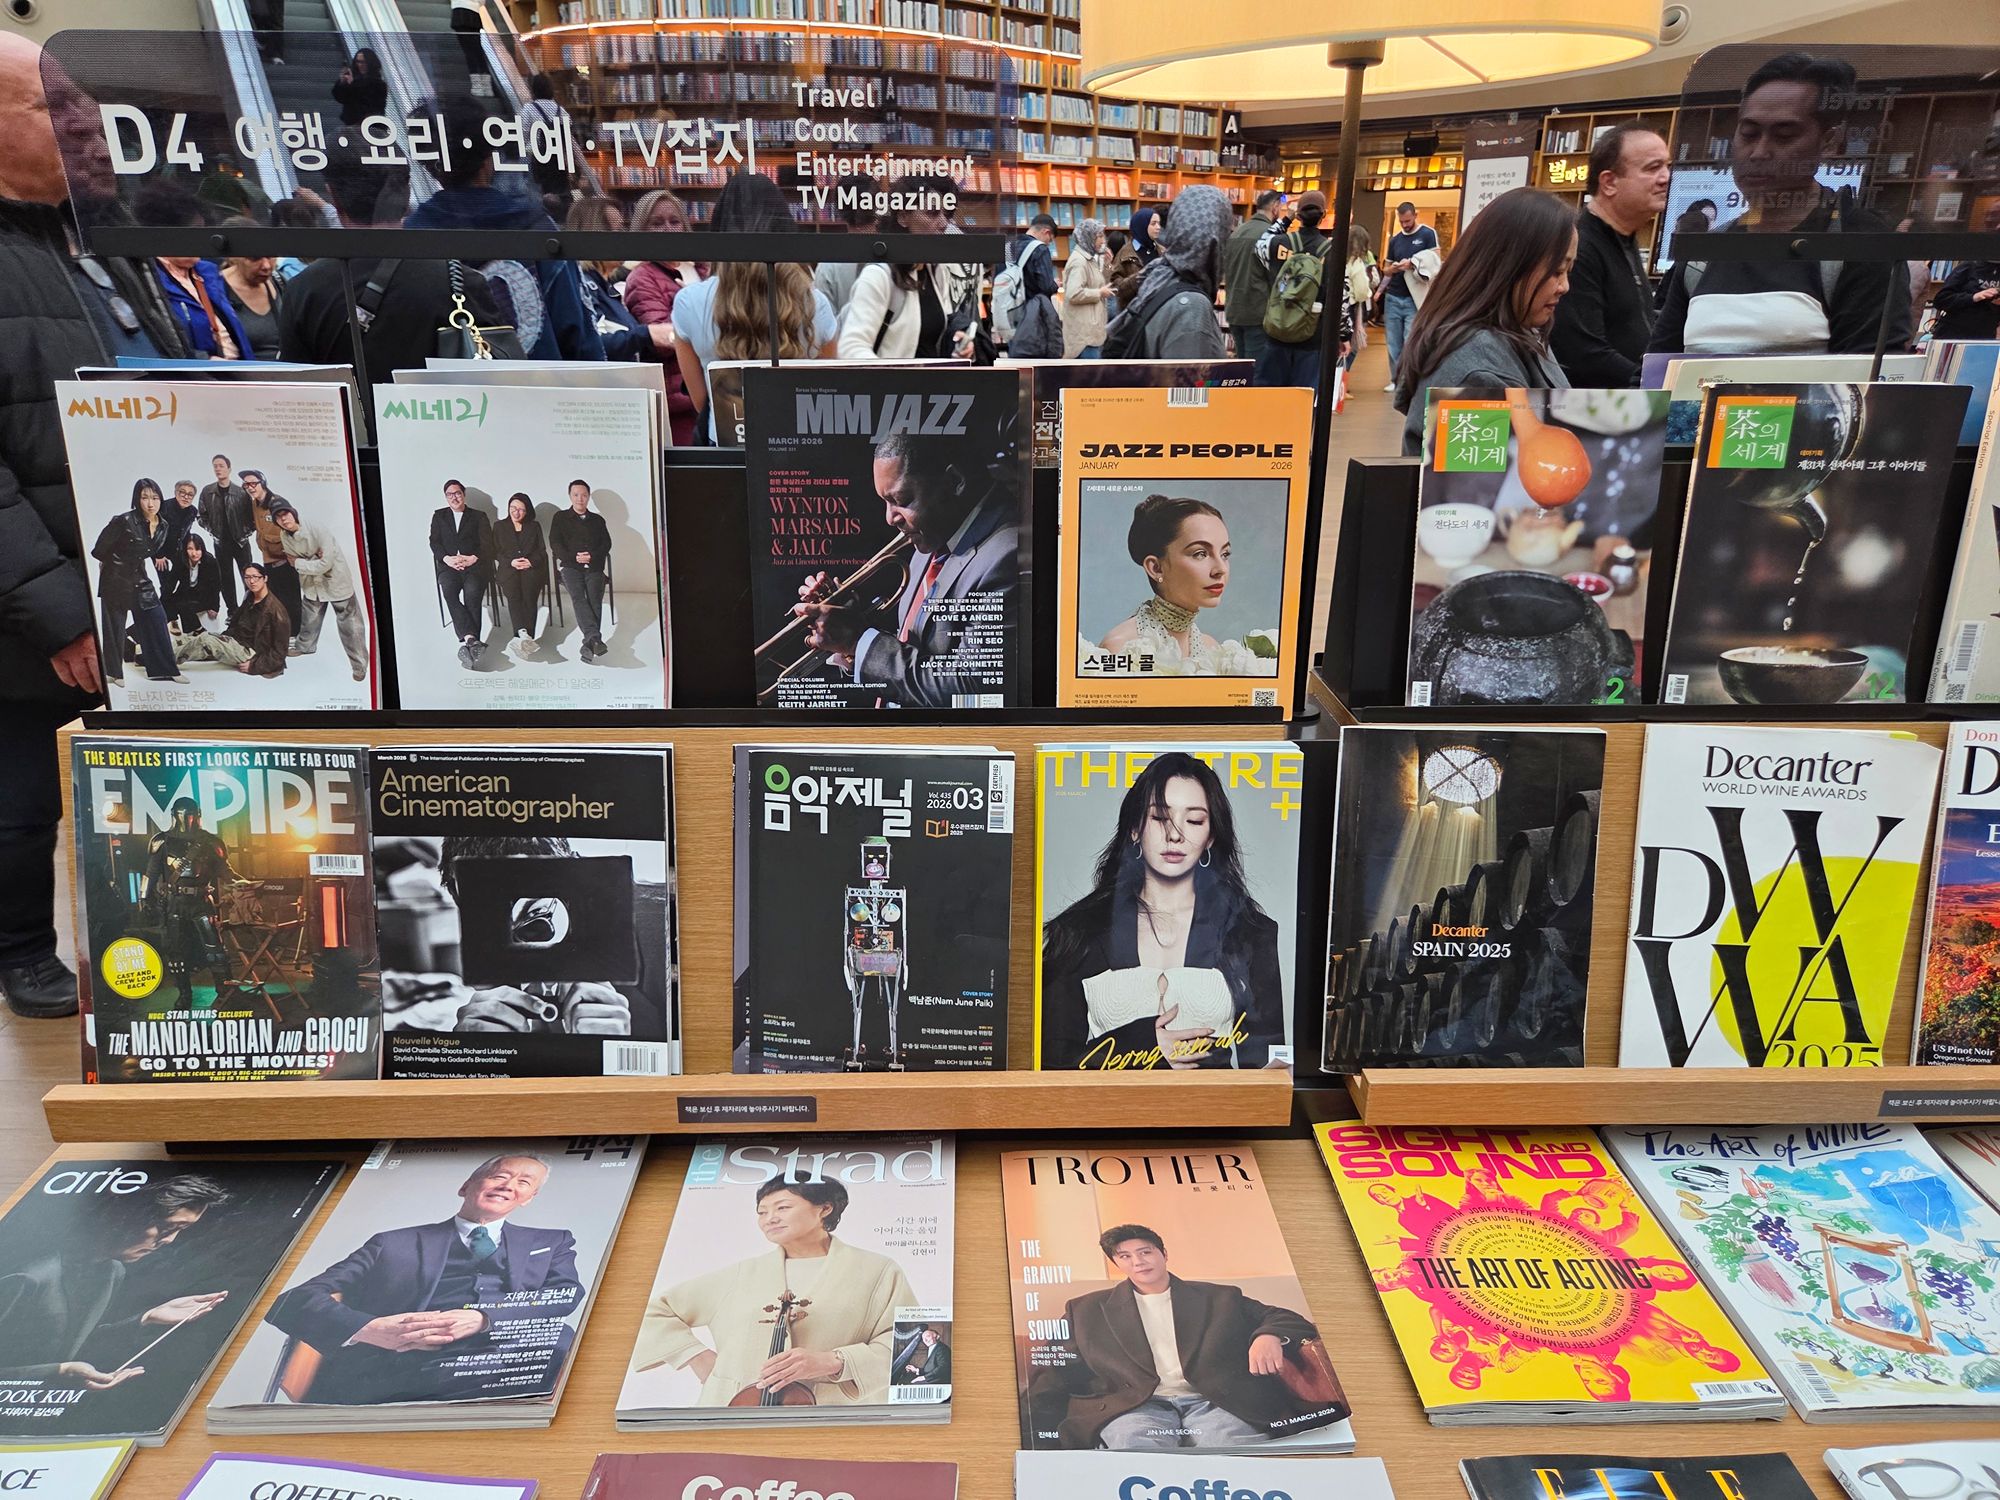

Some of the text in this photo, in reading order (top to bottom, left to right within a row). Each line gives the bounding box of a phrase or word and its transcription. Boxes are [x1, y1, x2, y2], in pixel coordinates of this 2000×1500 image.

[793, 82, 876, 108] Travel
[795, 118, 858, 142] Cook
[1225, 115, 1238, 133] A
[101, 104, 203, 174] D4
[797, 153, 974, 177] Entertainment
[797, 186, 957, 213] TV Magazine
[1450, 413, 1498, 444] 茶의
[1726, 409, 1780, 440] 茶의
[768, 437, 823, 445] MARCH 2026
[1080, 444, 1293, 458] JAZZ PEOPLE
[1079, 461, 1293, 470] JANUARY 2026
[1455, 446, 1505, 466] 세계
[1866, 460, 1886, 471] 그후
[1888, 460, 1927, 472] 이야기들
[769, 496, 849, 514] WYNTON
[770, 517, 861, 535] MARSALIS
[1083, 654, 1155, 672] 스텔라 콜
[128, 690, 164, 702] 끝나지
[166, 690, 191, 702] 않는
[778, 701, 805, 709] KEITH
[84, 750, 356, 769] THE BEATLES FIRST LOOKS AT THE FAB FOUR
[1702, 745, 1873, 786] Decanter
[1044, 751, 1304, 789] THETRE
[379, 768, 510, 793] American
[89, 767, 355, 835] EMPIRE
[764, 763, 913, 838] 음악저널
[952, 787, 984, 810] 03
[1702, 781, 1868, 801] WORLD WINE AWARDS
[380, 792, 614, 823] Cinematographer
[926, 799, 953, 809] 2026
[1431, 923, 1489, 938] Decanter
[112, 945, 145, 960] STAND
[1412, 941, 1512, 959] SPAIN 2025
[954, 998, 974, 1007] June
[974, 999, 994, 1008] Paik)
[109, 1017, 369, 1056] THE MANDALORIAN AND GROGU
[392, 1036, 460, 1047] Nouvelle Vague
[1079, 1036, 1164, 1070] Jeong
[1932, 1044, 1995, 1056] US Pinot Noir
[139, 1054, 335, 1071] GO TO THE MOVIES!
[684, 1105, 810, 1114] 책은 보신 후 제자리에 놓아주시기 바랍니다.
[1327, 1125, 1592, 1155] SIGHT AND
[1625, 1123, 1891, 1167] The ART of WINE
[691, 1148, 723, 1183] the
[721, 1139, 947, 1185] Strad
[1338, 1150, 1607, 1180] SOUND
[43, 1166, 149, 1196] arte
[873, 1226, 915, 1234] 이어지는
[896, 1216, 914, 1224] 시간
[1425, 1206, 1617, 1257] INTERVIEWS WITH JODIE FOSTER JESSIE BUCKLEY
[1020, 1239, 1041, 1258] THE
[1023, 1264, 1072, 1285] GRAVITY
[1412, 1257, 1654, 1290] THE ART OF ACTING
[504, 1287, 577, 1302] 지휘자 금난새
[1025, 1292, 1040, 1312] OF
[1028, 1319, 1070, 1341] SOUND
[40, 1389, 87, 1404] KIM
[2, 1407, 65, 1417] 지휘자 김선욱
[1270, 1407, 1336, 1428] NO.1 MARCH 2026
